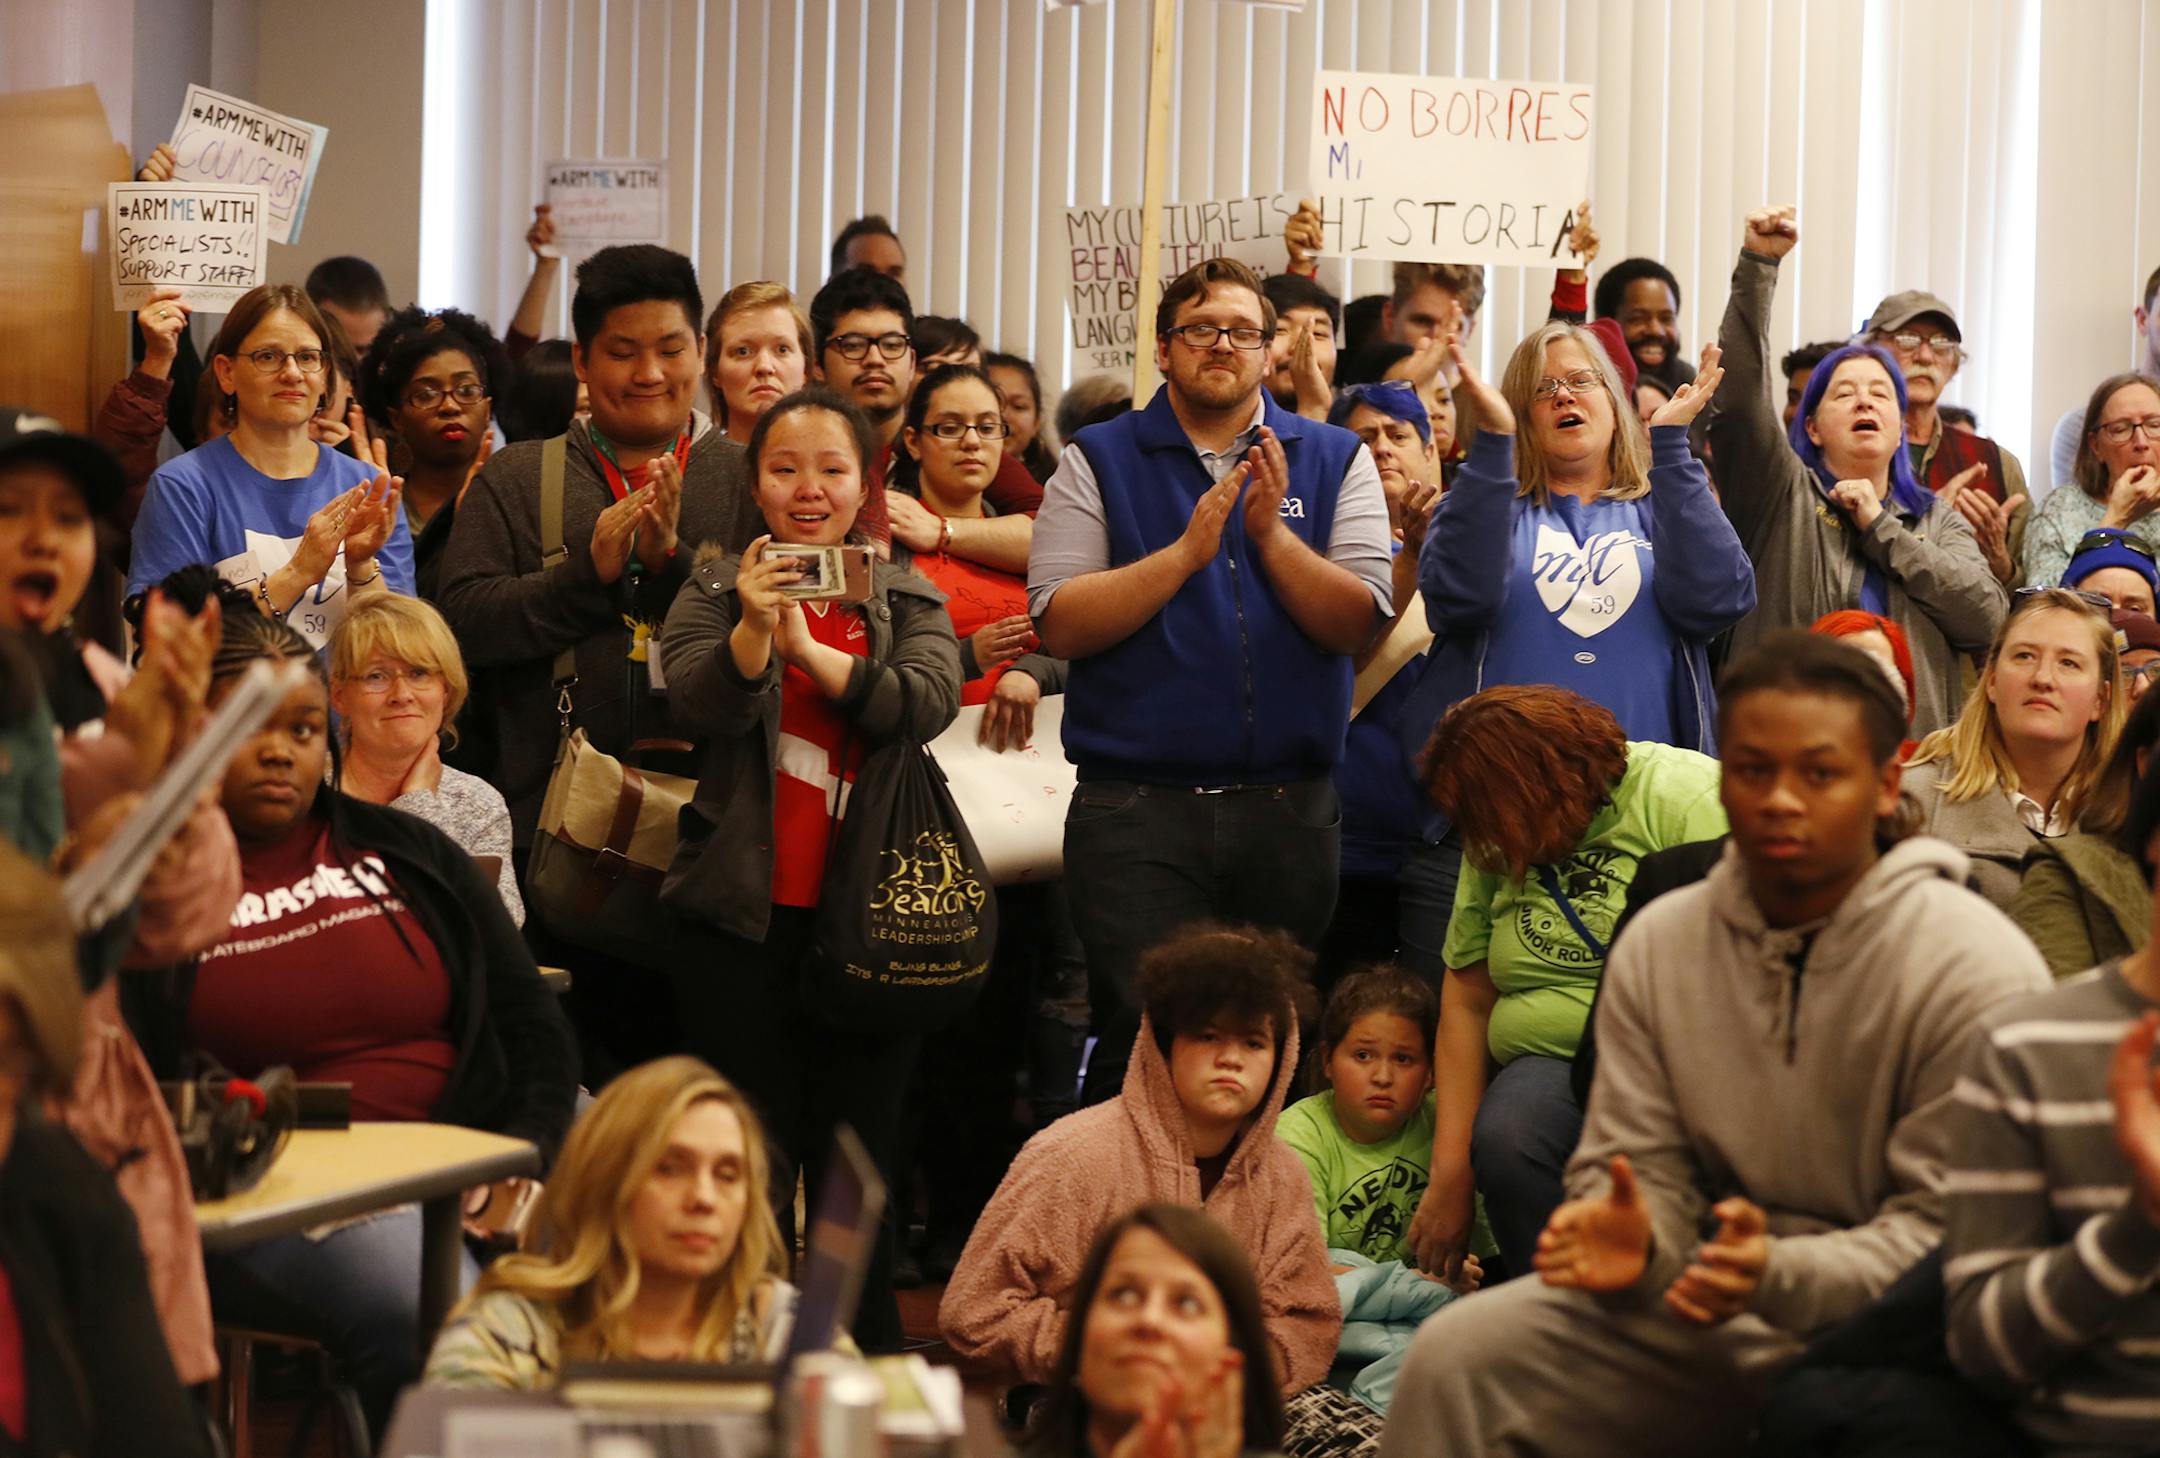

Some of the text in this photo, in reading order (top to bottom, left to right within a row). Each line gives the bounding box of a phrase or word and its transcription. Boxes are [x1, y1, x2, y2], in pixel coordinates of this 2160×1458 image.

[1324, 86, 1591, 143] NO BORRES
[1066, 193, 1292, 247] MY CUTURE IS
[1319, 196, 1578, 259] HISTORIA
[119, 257, 193, 280] SUPPORT
[1073, 281, 1112, 315] MY
[1590, 594, 1616, 615] 59
[303, 614, 326, 634] 59
[230, 856, 390, 928] RASHER
[871, 927, 952, 945] LEADERSHIP
